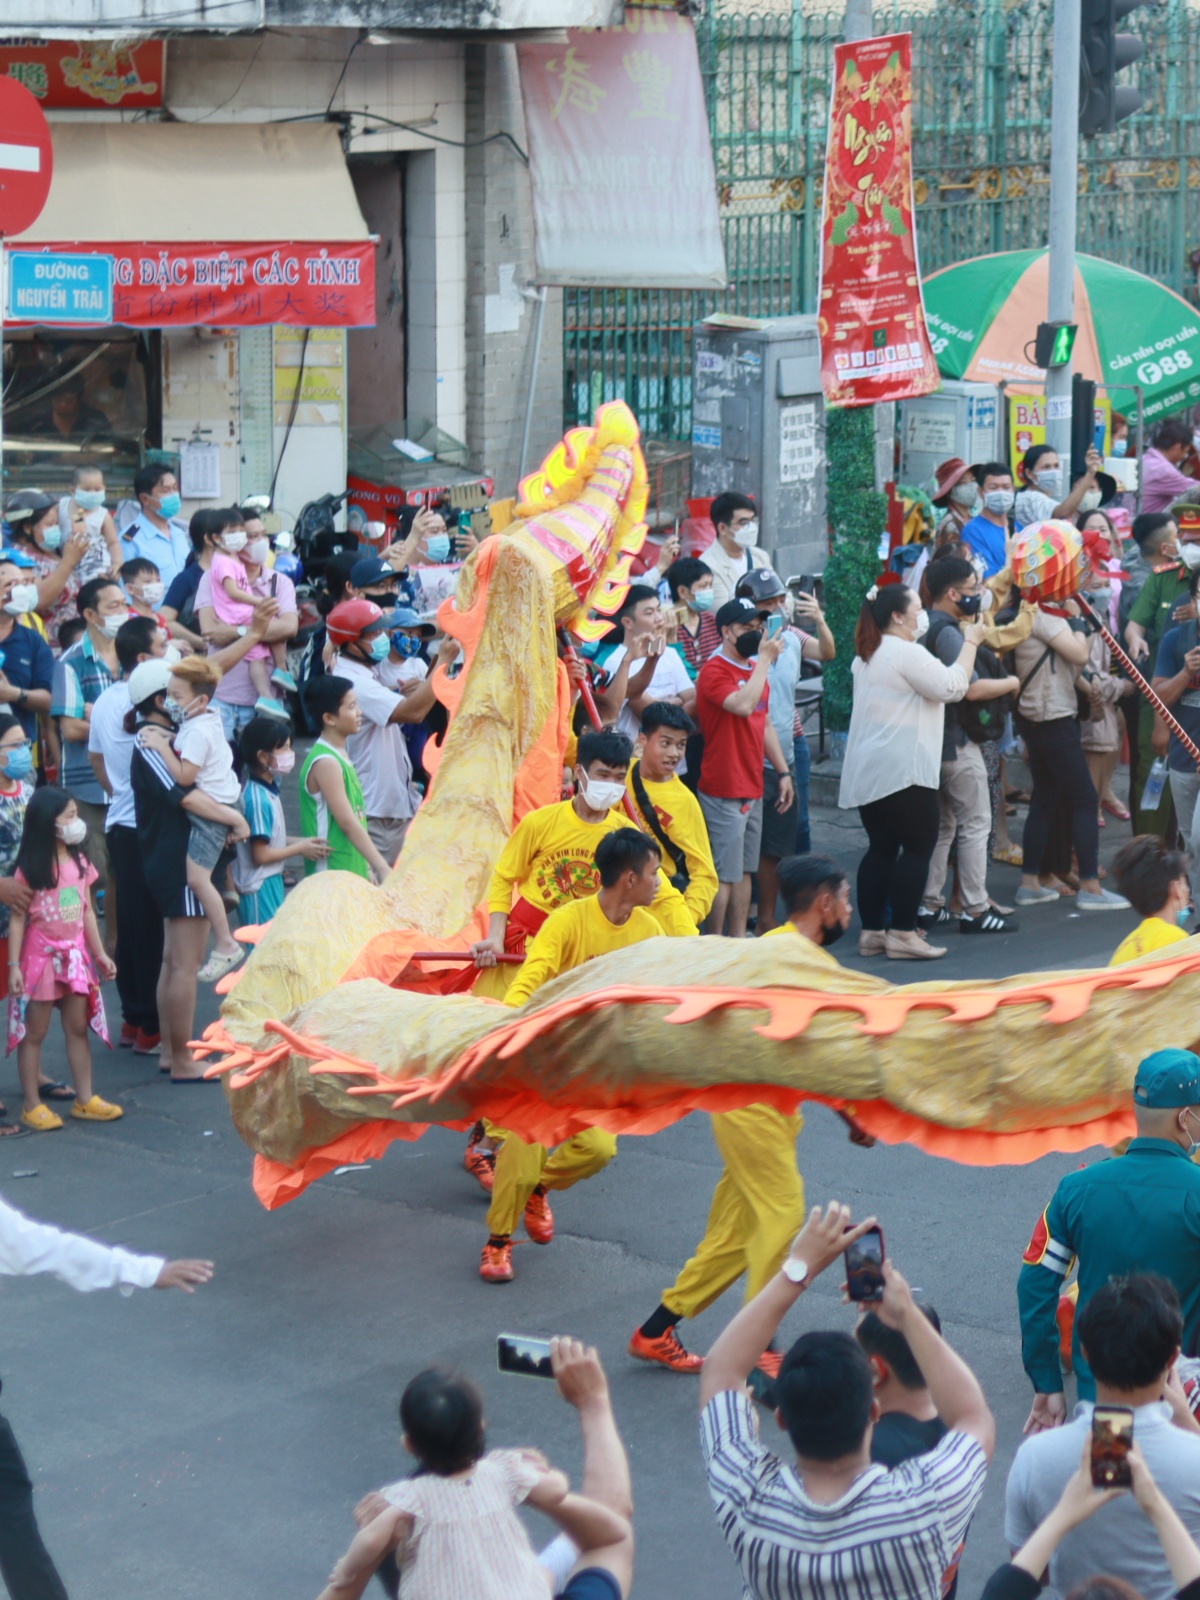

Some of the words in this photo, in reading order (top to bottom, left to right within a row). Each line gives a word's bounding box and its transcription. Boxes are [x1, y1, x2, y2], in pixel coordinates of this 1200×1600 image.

[844, 113, 893, 166] Nguyên
[35, 261, 89, 280] ĐƯỜNG
[140, 250, 188, 292] ĐẶC
[193, 251, 247, 292] BIỆT
[253, 250, 299, 286] CÁC
[305, 248, 360, 286] TỈNH
[17, 284, 67, 309] NGUYỄN
[73, 285, 103, 310] TRÃI
[1109, 354, 1133, 370] CẦN
[1132, 345, 1155, 361] TIỀN
[1155, 336, 1176, 351] GỌI
[1176, 325, 1199, 342] LIỀN
[1137, 349, 1193, 385] F88
[280, 387, 333, 397] JAKPOT
[571, 848, 590, 858] LONG
